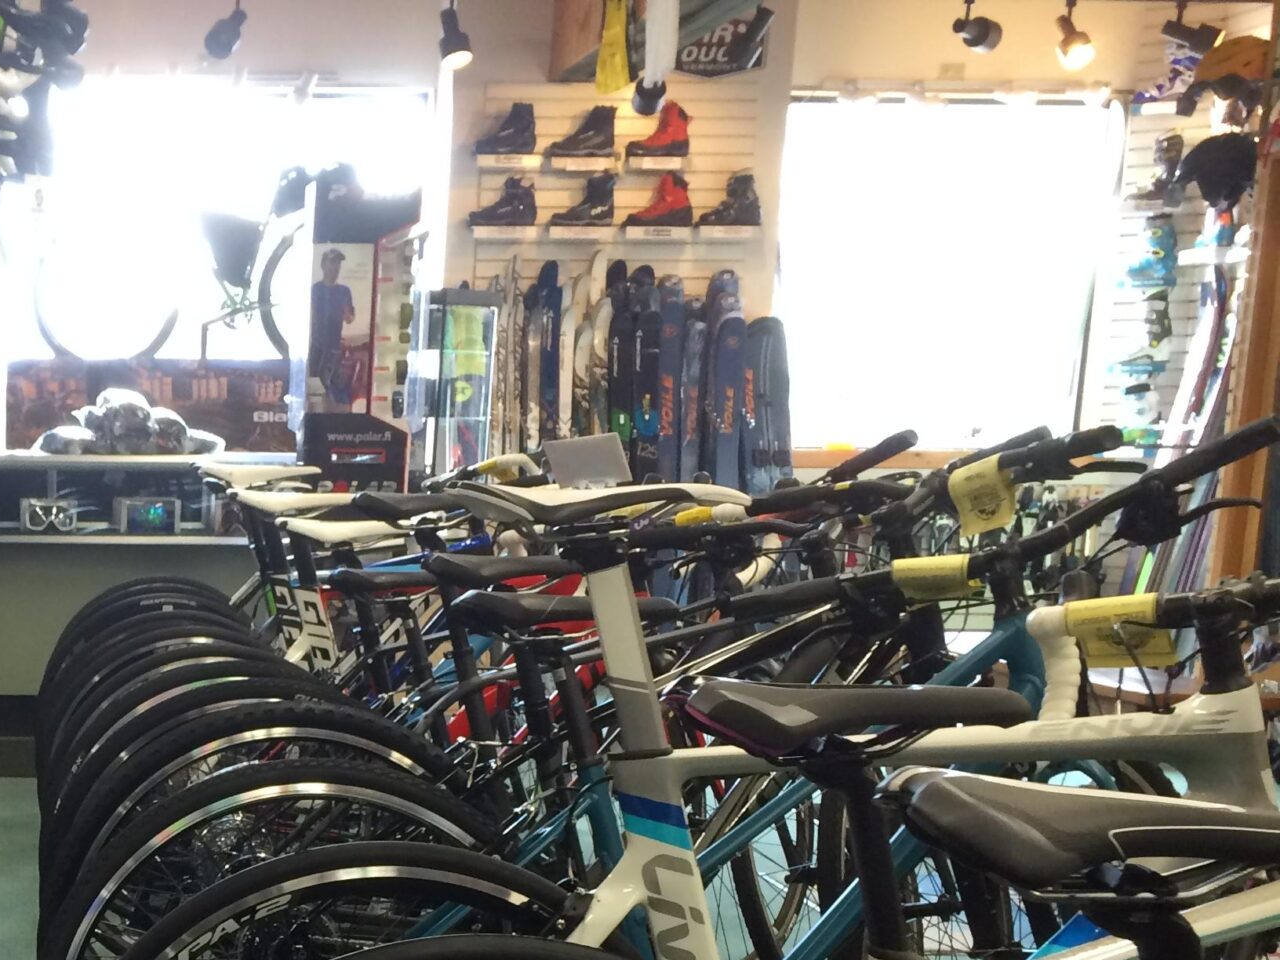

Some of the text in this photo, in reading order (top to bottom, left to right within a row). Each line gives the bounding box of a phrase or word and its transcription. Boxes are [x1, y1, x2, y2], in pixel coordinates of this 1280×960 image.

[661, 374, 673, 435] VOILE
[723, 387, 734, 433] VOILE
[253, 411, 287, 423] Bla
[327, 431, 391, 443] www.polar.fi
[636, 442, 658, 460] 125
